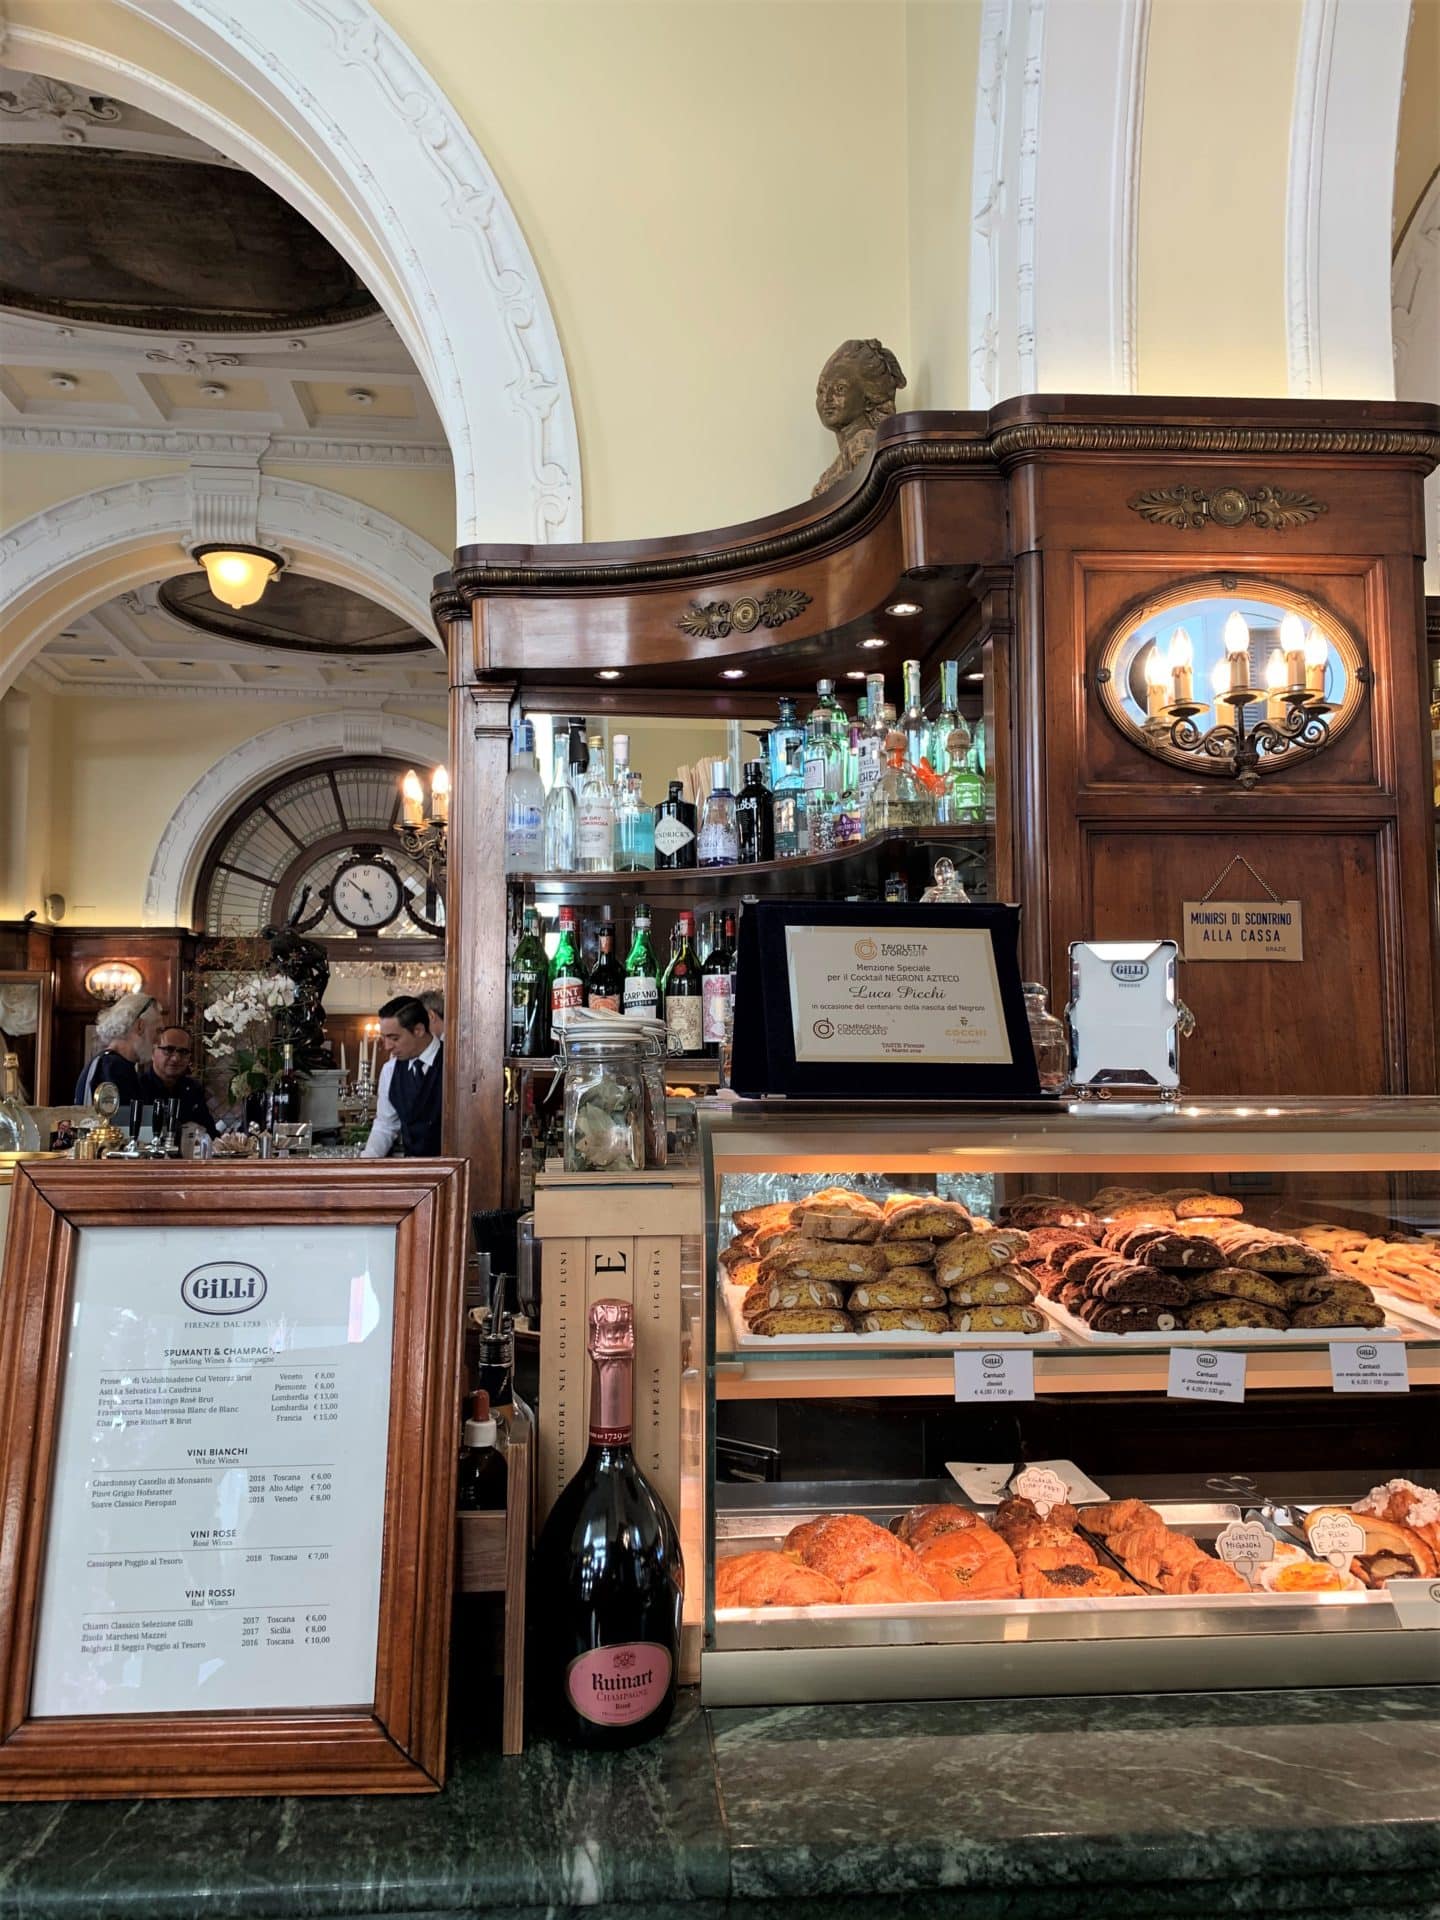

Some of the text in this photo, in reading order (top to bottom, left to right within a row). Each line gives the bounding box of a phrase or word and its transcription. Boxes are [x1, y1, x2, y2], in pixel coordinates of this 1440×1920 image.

[1190, 912, 1292, 926] MUNIRSI DI SCONTRINO
[1203, 929, 1281, 942] ALLA CASSA
[880, 943, 928, 951] TAVOLETTA
[856, 963, 931, 973] Menzione Speciale
[827, 973, 960, 983] per il Cocktail NEGRONI AZTECO
[553, 986, 578, 1000] PUNT
[624, 990, 657, 1001] CARPANO
[848, 985, 946, 999] Luca Picchi
[866, 1003, 901, 1011] centenario
[903, 1003, 920, 1011] della
[946, 1003, 958, 1011] del
[958, 1004, 985, 1013] Negroni
[560, 1250, 568, 1284] LUNI
[653, 1249, 661, 1320] LIGURIA
[559, 1294, 567, 1307] DI
[184, 1320, 220, 1329] FIRENZE
[223, 1320, 241, 1328] DAL
[559, 1317, 567, 1359] COLLI
[163, 1346, 281, 1357] SPUMANTI & CHAMPAG
[170, 1357, 203, 1367] Sparkling
[205, 1356, 225, 1365] Wines
[559, 1368, 567, 1392] NEI
[274, 1383, 307, 1392] Piemonte
[271, 1393, 309, 1401] Lombardia
[187, 1406, 207, 1415] Blanc
[208, 1406, 218, 1414] de
[218, 1405, 240, 1413] Blanc
[271, 1403, 309, 1412] Lombardia
[176, 1417, 192, 1425] Brut
[276, 1414, 302, 1422] Francia
[652, 1367, 660, 1470] LA SPEZIA
[604, 1432, 623, 1442] 1729
[187, 1447, 248, 1457] VINI BIANCHI
[194, 1456, 240, 1465] White Wines
[92, 1476, 213, 1488] Chardonnay Castello di Monsanto
[272, 1473, 301, 1481] Toscana
[91, 1489, 111, 1498] Pinot
[112, 1489, 135, 1498] Grigio
[268, 1484, 283, 1492] Alto
[283, 1484, 304, 1493] Adige
[90, 1498, 177, 1509] Soave Classico Pieropan
[274, 1494, 298, 1503] Veneto
[190, 1529, 210, 1539] VINI
[211, 1537, 233, 1546] Wines
[1225, 1541, 1262, 1550] MIGNON
[245, 1552, 329, 1562] 2018 Toscana 7,00
[86, 1556, 183, 1569] Cassiopea Poggio al Tesoro
[184, 1588, 236, 1599] VINI ROSSI
[191, 1599, 229, 1607] Red Wines
[242, 1614, 327, 1624] 2017 Toscana 6,00
[82, 1618, 193, 1631] Chianti Classico Selezione Gilli
[105, 1631, 139, 1641] Marchesi
[141, 1630, 167, 1640] Mazzei
[241, 1627, 259, 1635] 2017
[269, 1626, 291, 1634] Sicilia
[146, 1642, 171, 1652] Poggio
[172, 1642, 180, 1650] al
[181, 1641, 206, 1650] Tesoro
[240, 1636, 330, 1647] 2016 Toscana 10,00
[591, 1668, 654, 1692] Ruinart
[596, 1688, 649, 1703] CHAMPAGNE
